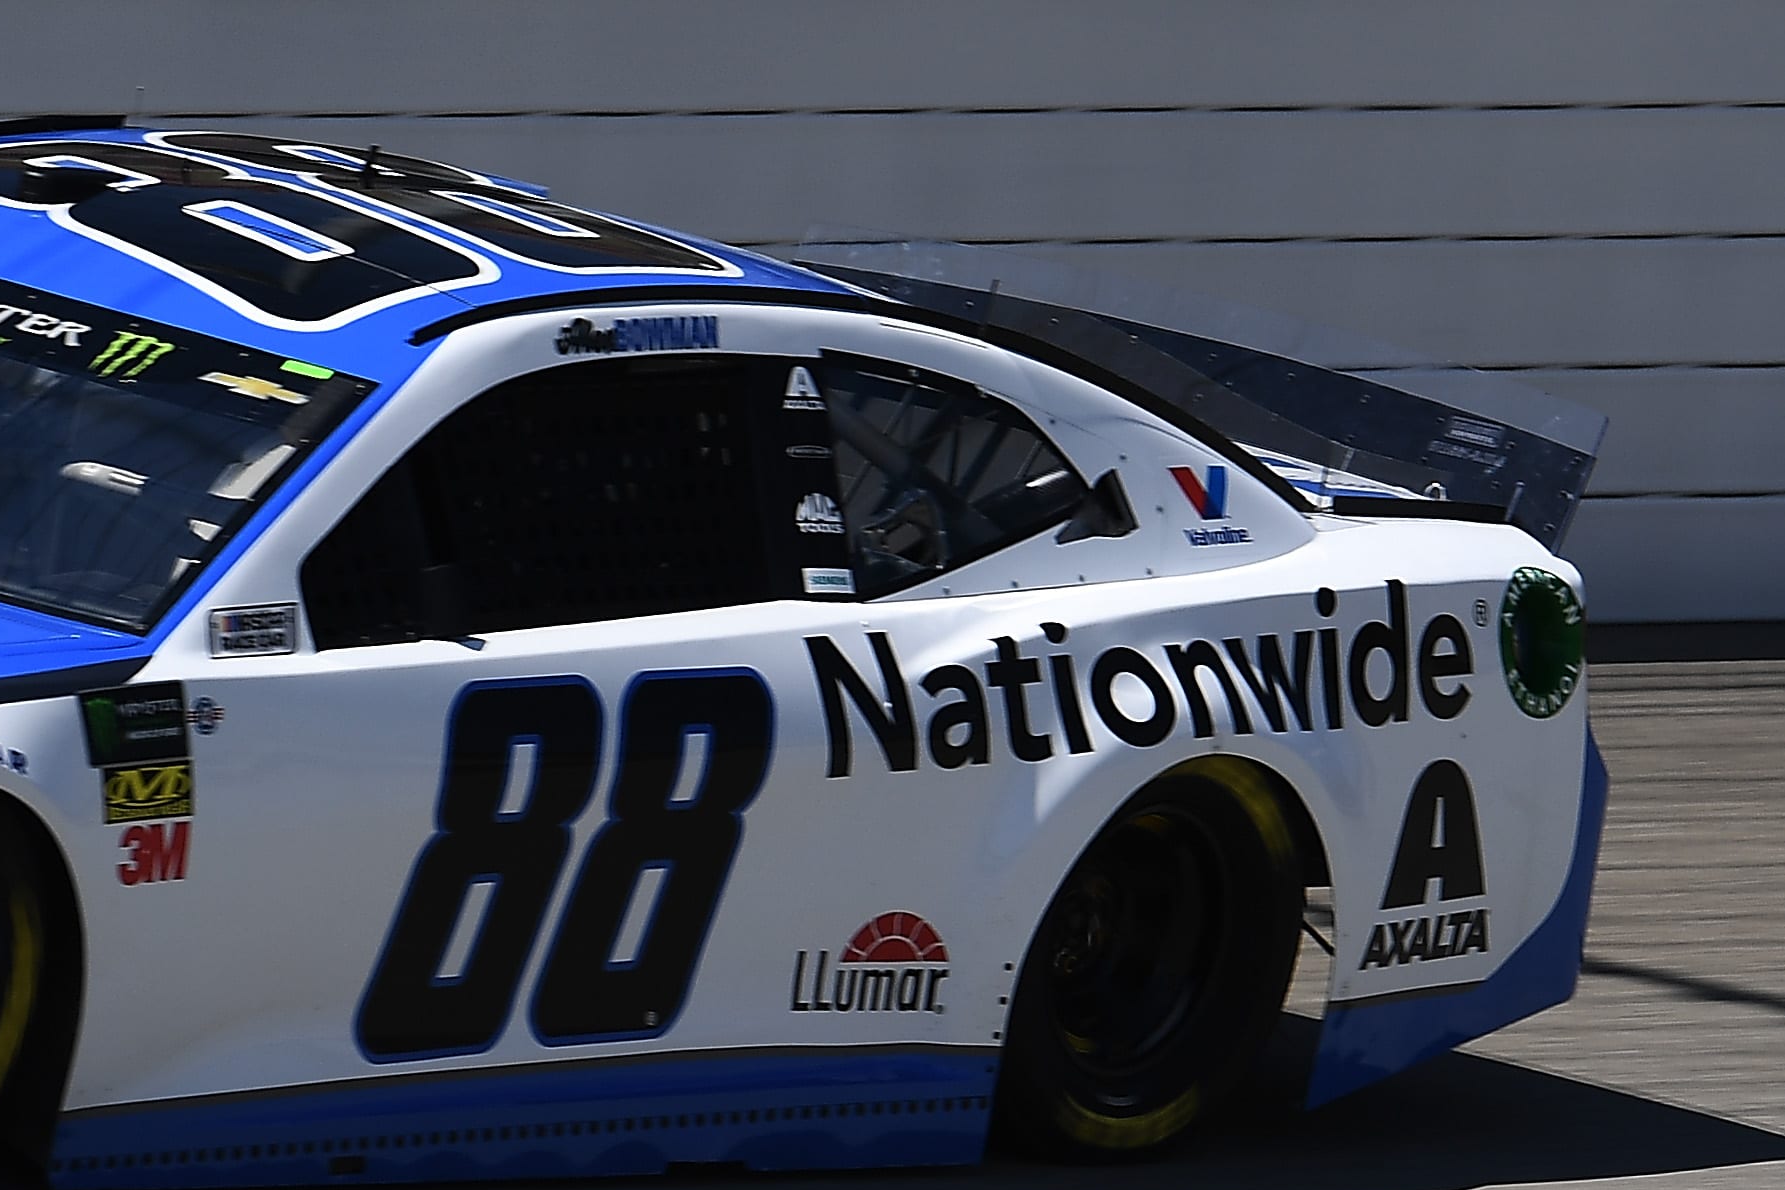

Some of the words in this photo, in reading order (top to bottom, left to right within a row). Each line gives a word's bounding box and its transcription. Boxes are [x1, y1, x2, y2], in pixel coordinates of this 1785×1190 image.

[802, 578, 1474, 779] Nationwide
[116, 822, 191, 887] 3M
[351, 664, 779, 1067] 88
[1357, 907, 1492, 972] AXALTA
